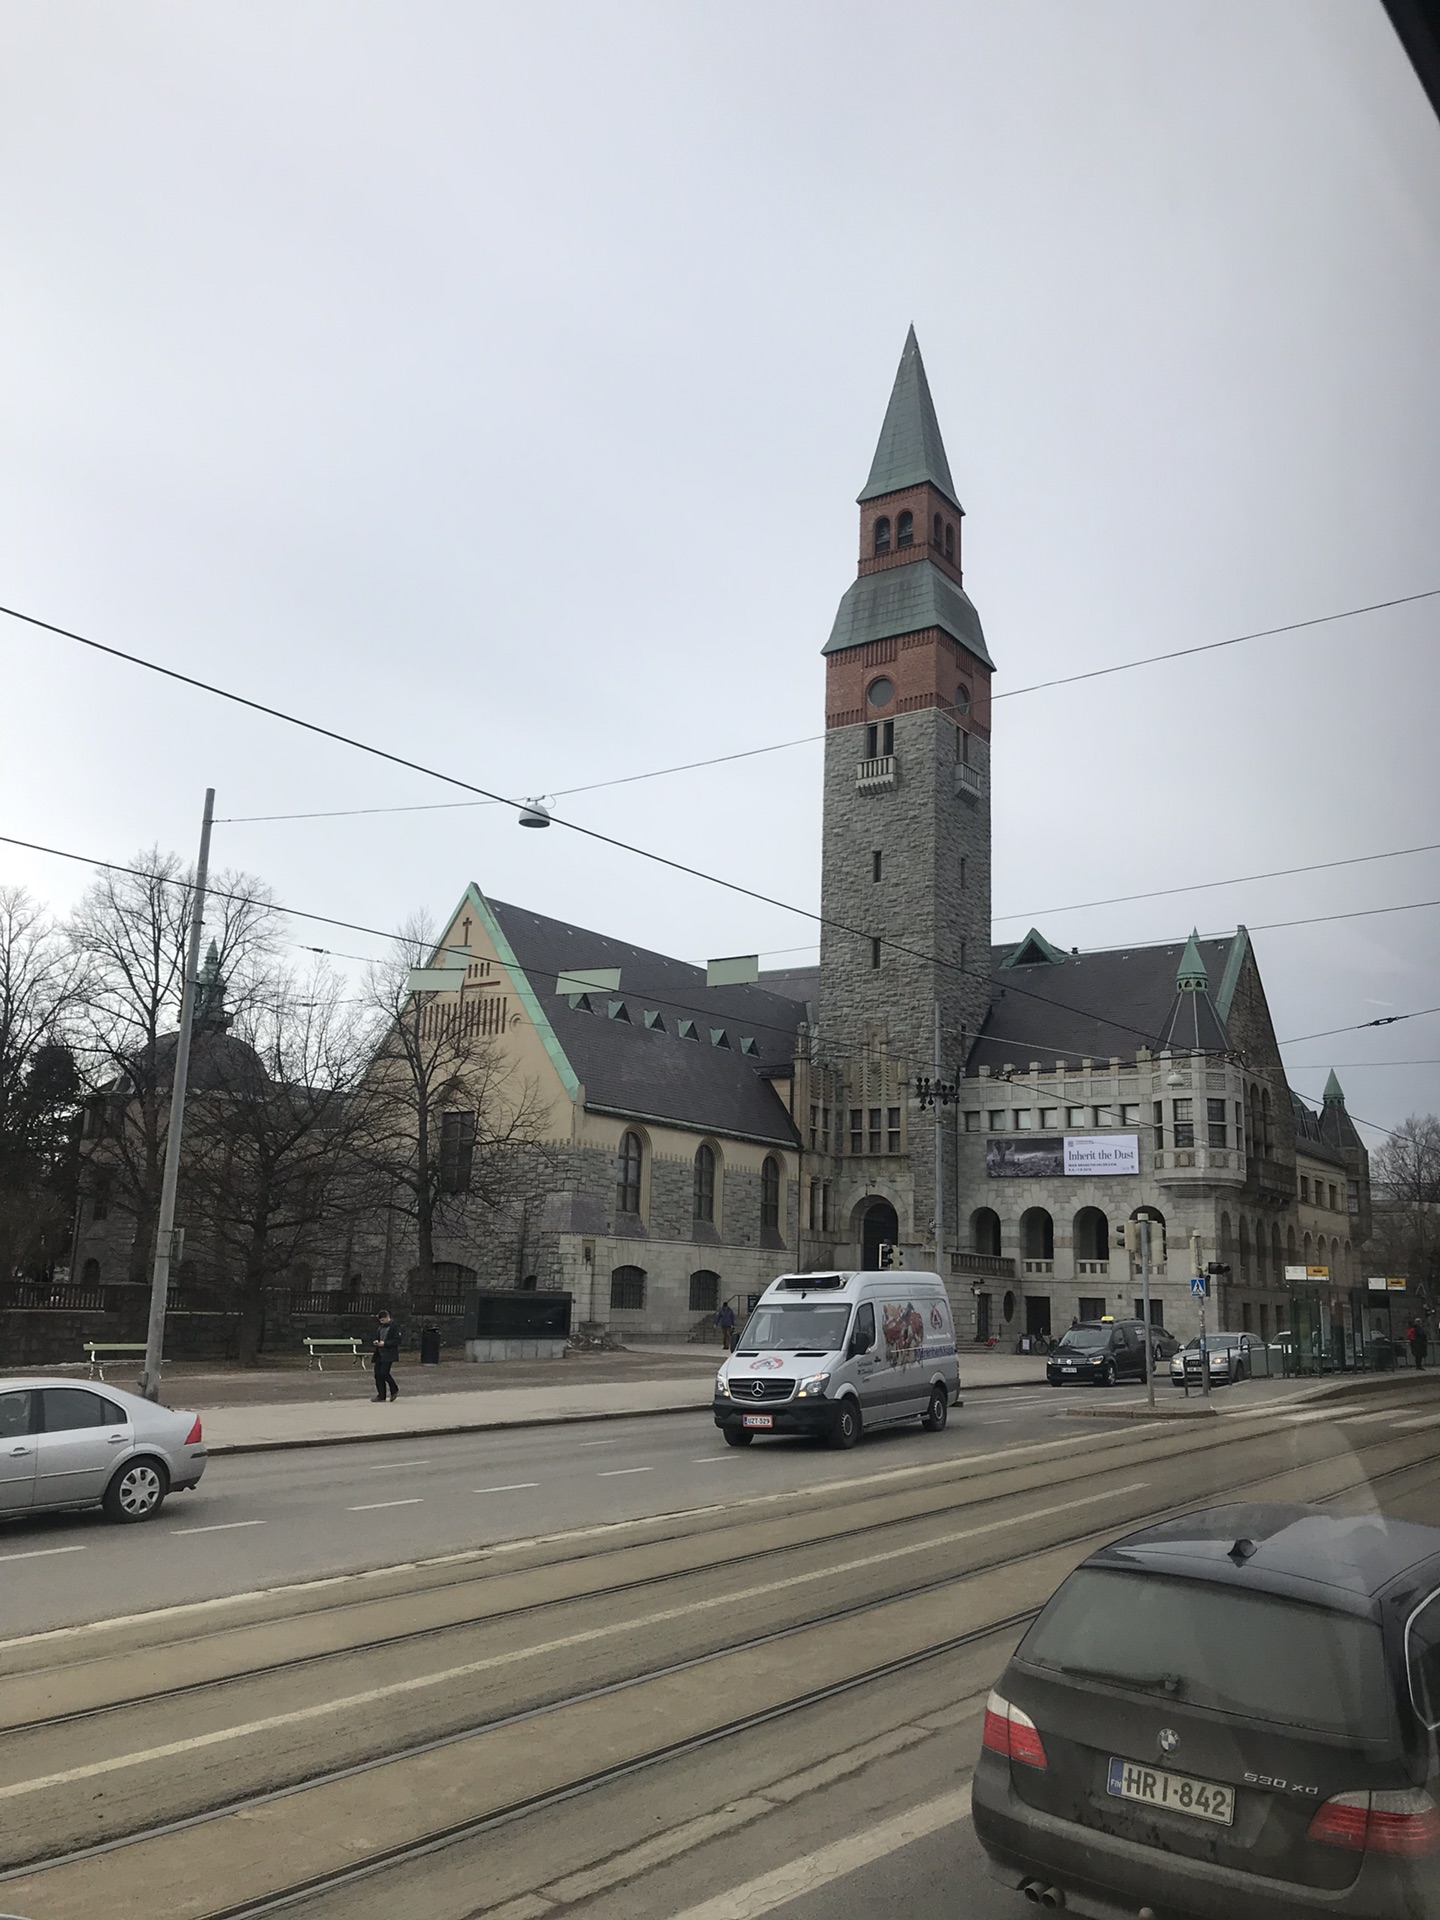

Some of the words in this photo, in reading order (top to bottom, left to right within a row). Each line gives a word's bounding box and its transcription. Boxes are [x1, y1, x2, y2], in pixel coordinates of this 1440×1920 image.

[1069, 1151, 1096, 1160] Inherit
[1098, 1150, 1112, 1160] the
[1114, 1149, 1134, 1159] Dust
[1110, 1778, 1122, 1789] FIN
[1126, 1768, 1226, 1817] HRI-842
[1243, 1772, 1287, 1788] 530
[1291, 1783, 1319, 1795] xd
